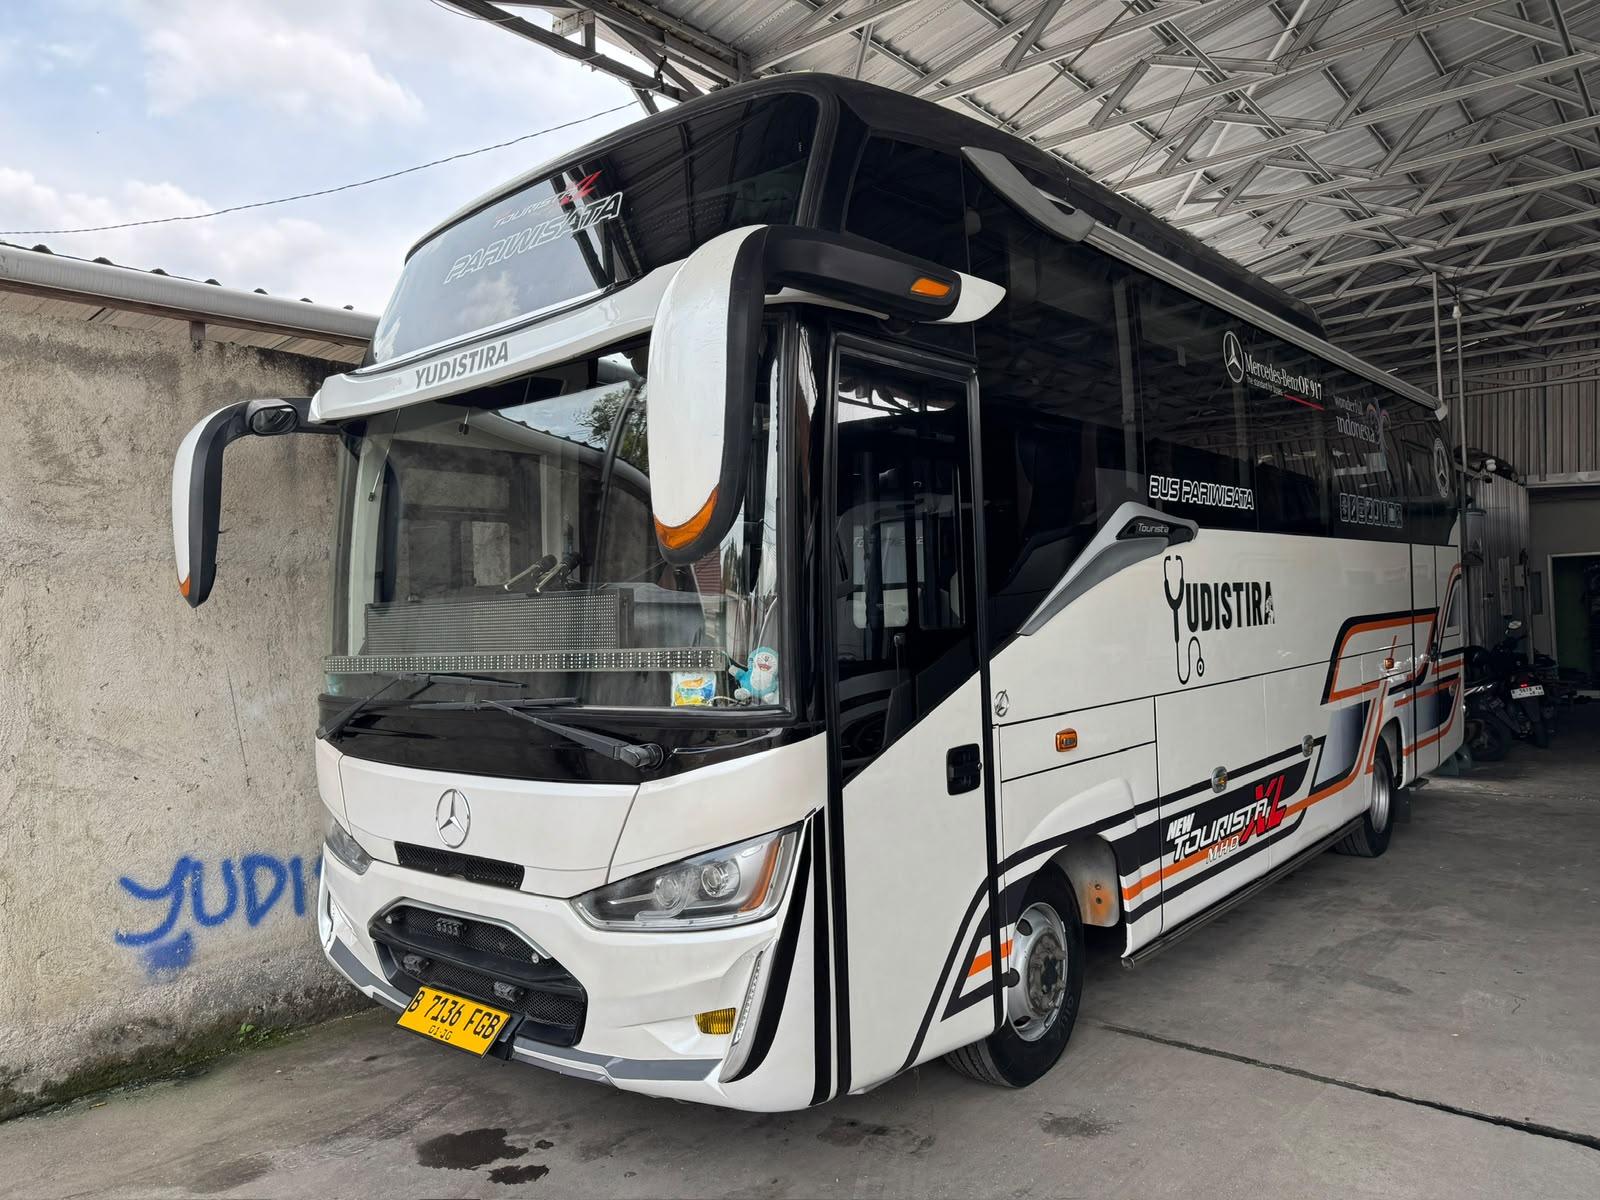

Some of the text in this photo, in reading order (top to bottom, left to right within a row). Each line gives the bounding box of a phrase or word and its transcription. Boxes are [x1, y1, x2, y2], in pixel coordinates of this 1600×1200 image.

[443, 191, 623, 285] PARIWISATA
[415, 341, 509, 390] YUDISTIRA
[1244, 351, 1300, 392] Mercedes-Benz
[1309, 379, 1322, 401] 917
[1149, 475, 1255, 510] BUS PARIWISATA
[1138, 522, 1170, 534] Tourista
[1164, 556, 1275, 643] YUDISTIRA
[1165, 812, 1196, 842] NEW
[1173, 774, 1287, 862] TOURISTA XL
[1206, 835, 1240, 865] MHD
[115, 855, 323, 947] YUDI
[407, 990, 501, 1040] B 7136 FGB
